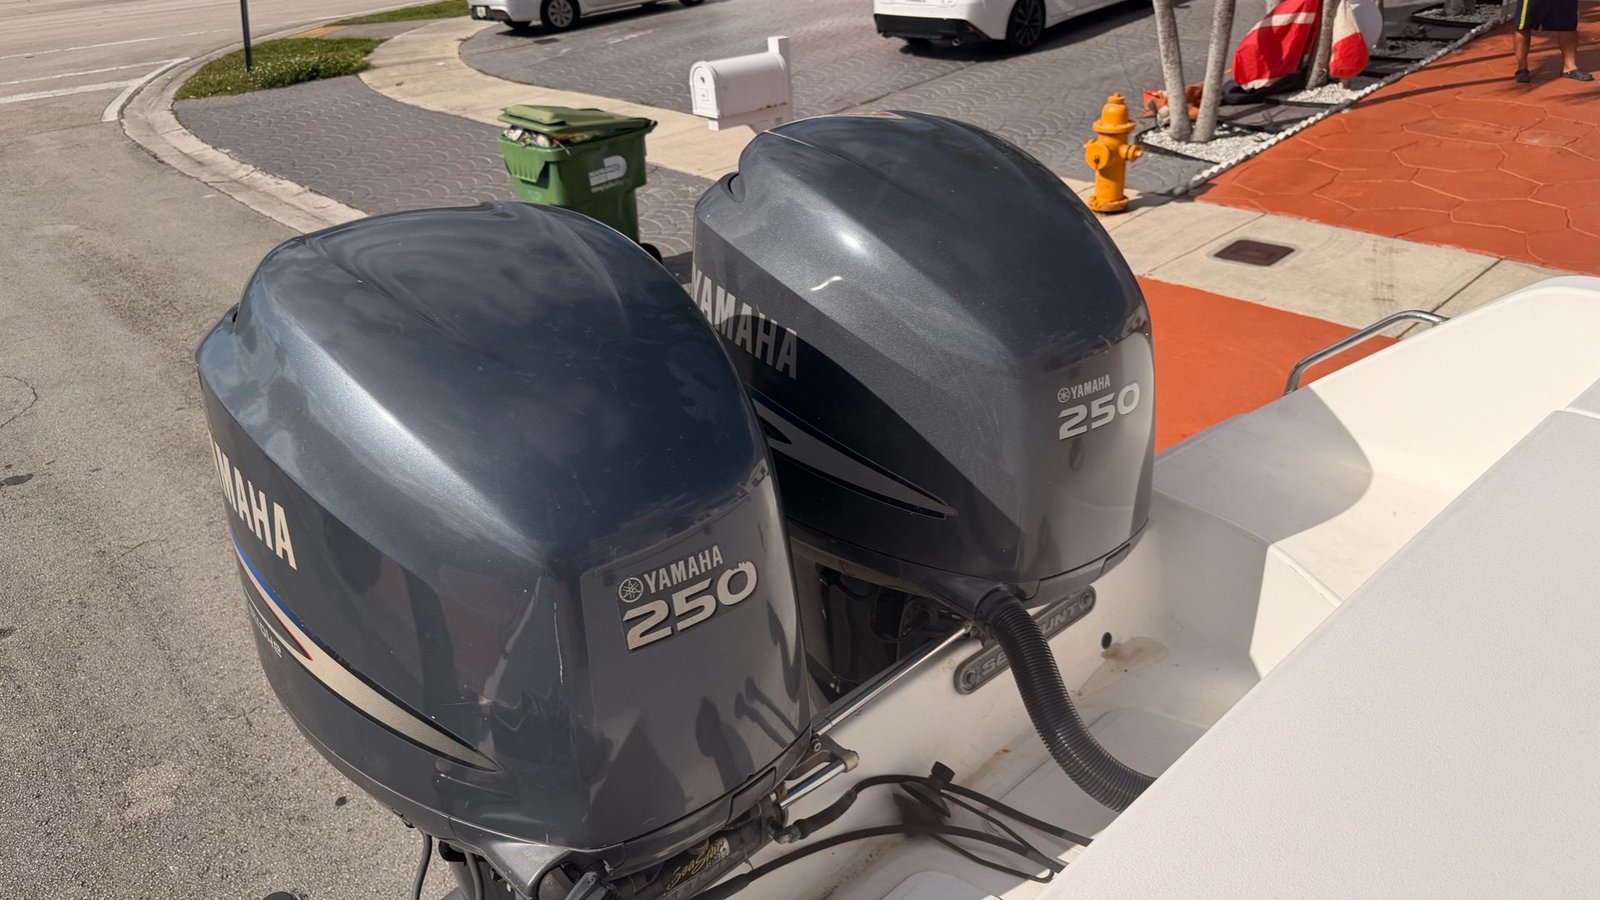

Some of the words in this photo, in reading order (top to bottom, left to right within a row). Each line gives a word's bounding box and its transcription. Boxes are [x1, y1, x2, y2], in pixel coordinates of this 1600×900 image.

[1058, 382, 1140, 440] 250
[1070, 374, 1111, 399] YAMAHA
[212, 441, 298, 571] MAHA
[643, 544, 724, 594] YAMAHA
[622, 561, 757, 650] 250
